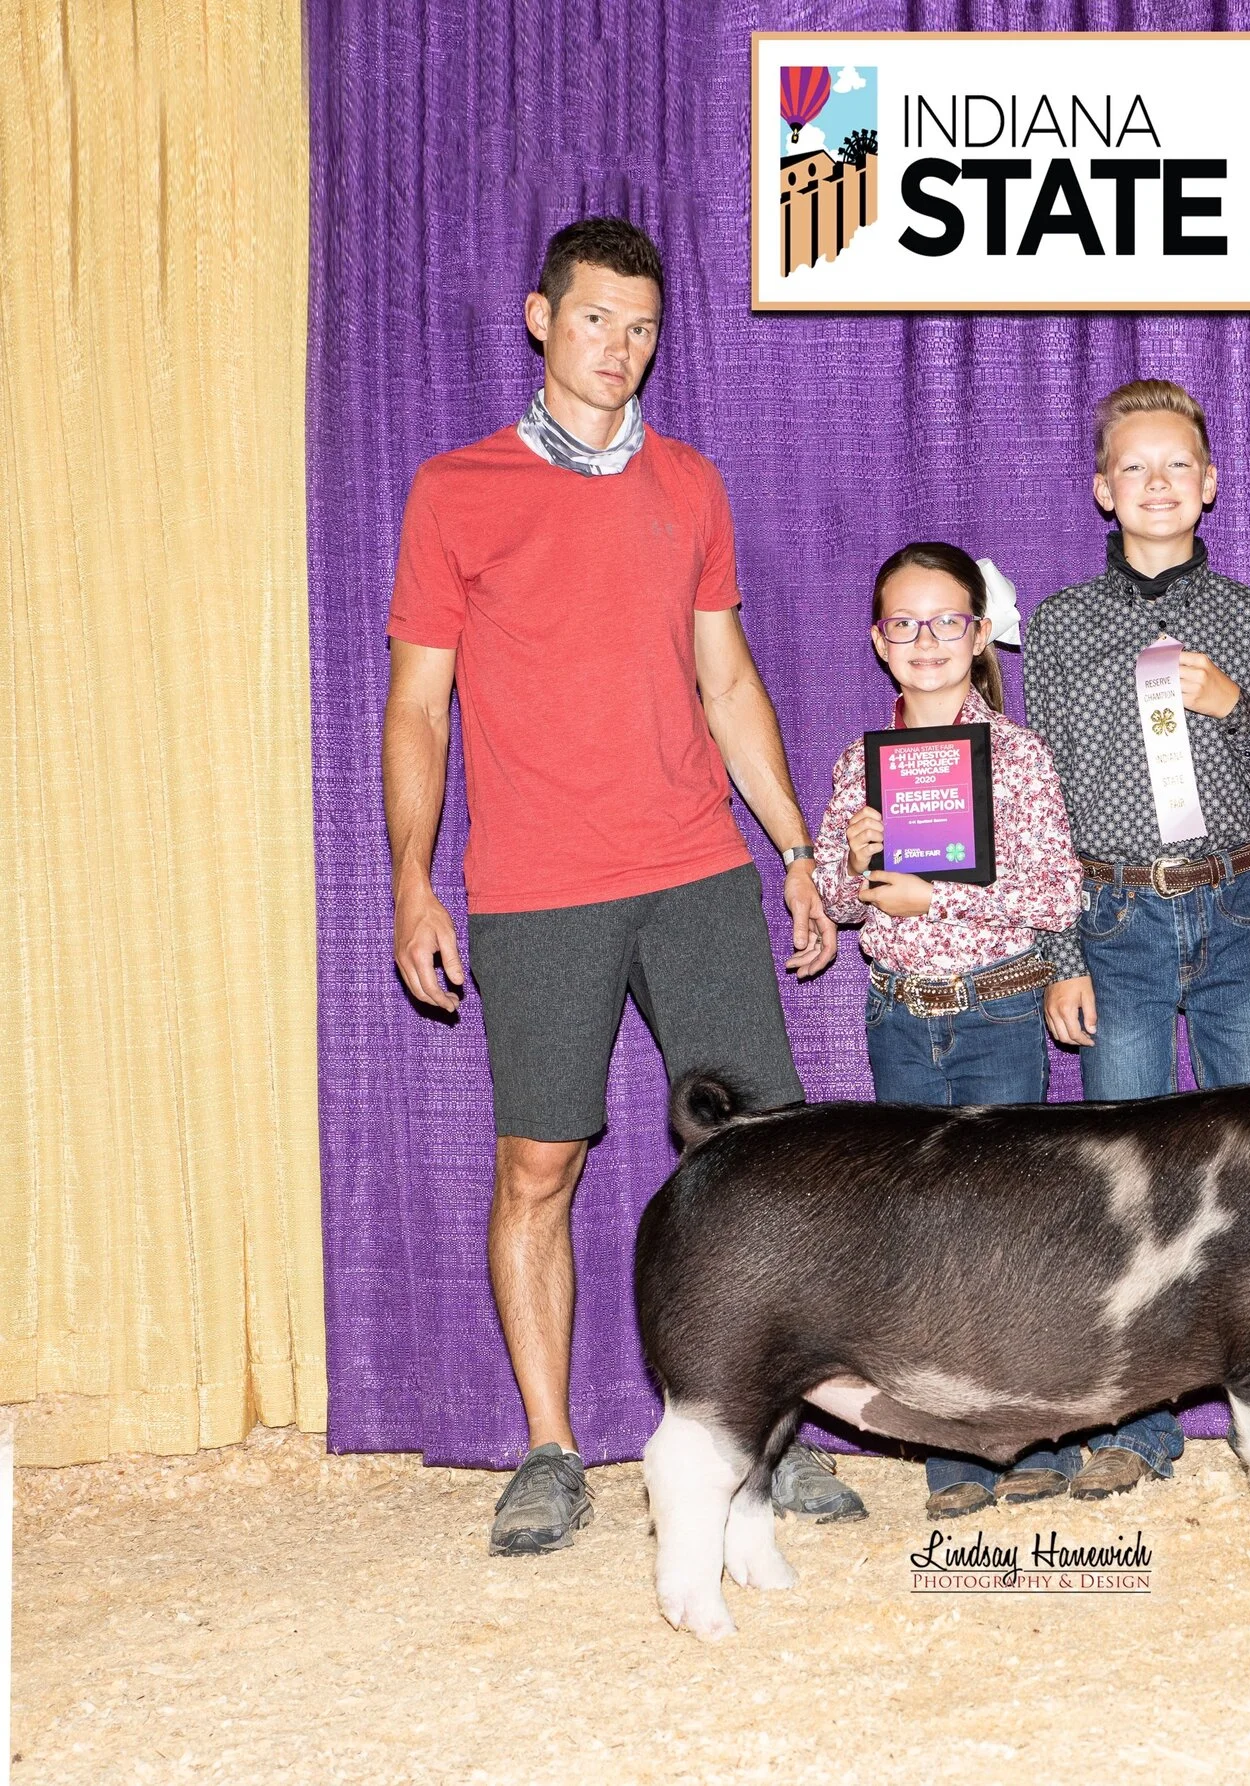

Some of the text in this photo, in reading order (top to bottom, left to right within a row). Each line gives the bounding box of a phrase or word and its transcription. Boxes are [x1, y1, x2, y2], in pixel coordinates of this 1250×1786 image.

[903, 94, 1162, 148] INDIANA
[898, 157, 1228, 258] STATE
[1145, 676, 1171, 688] RESERVE
[889, 749, 960, 762] 4-H LIVESTOCK
[894, 746, 920, 754] INDIANA
[889, 757, 960, 770] & 4-H PROJECT
[900, 766, 950, 777] SHOWCASE
[914, 775, 937, 785] 2020
[895, 788, 959, 803] RESERVE
[890, 799, 965, 815] CHAMPION
[925, 849, 941, 857] FAIR
